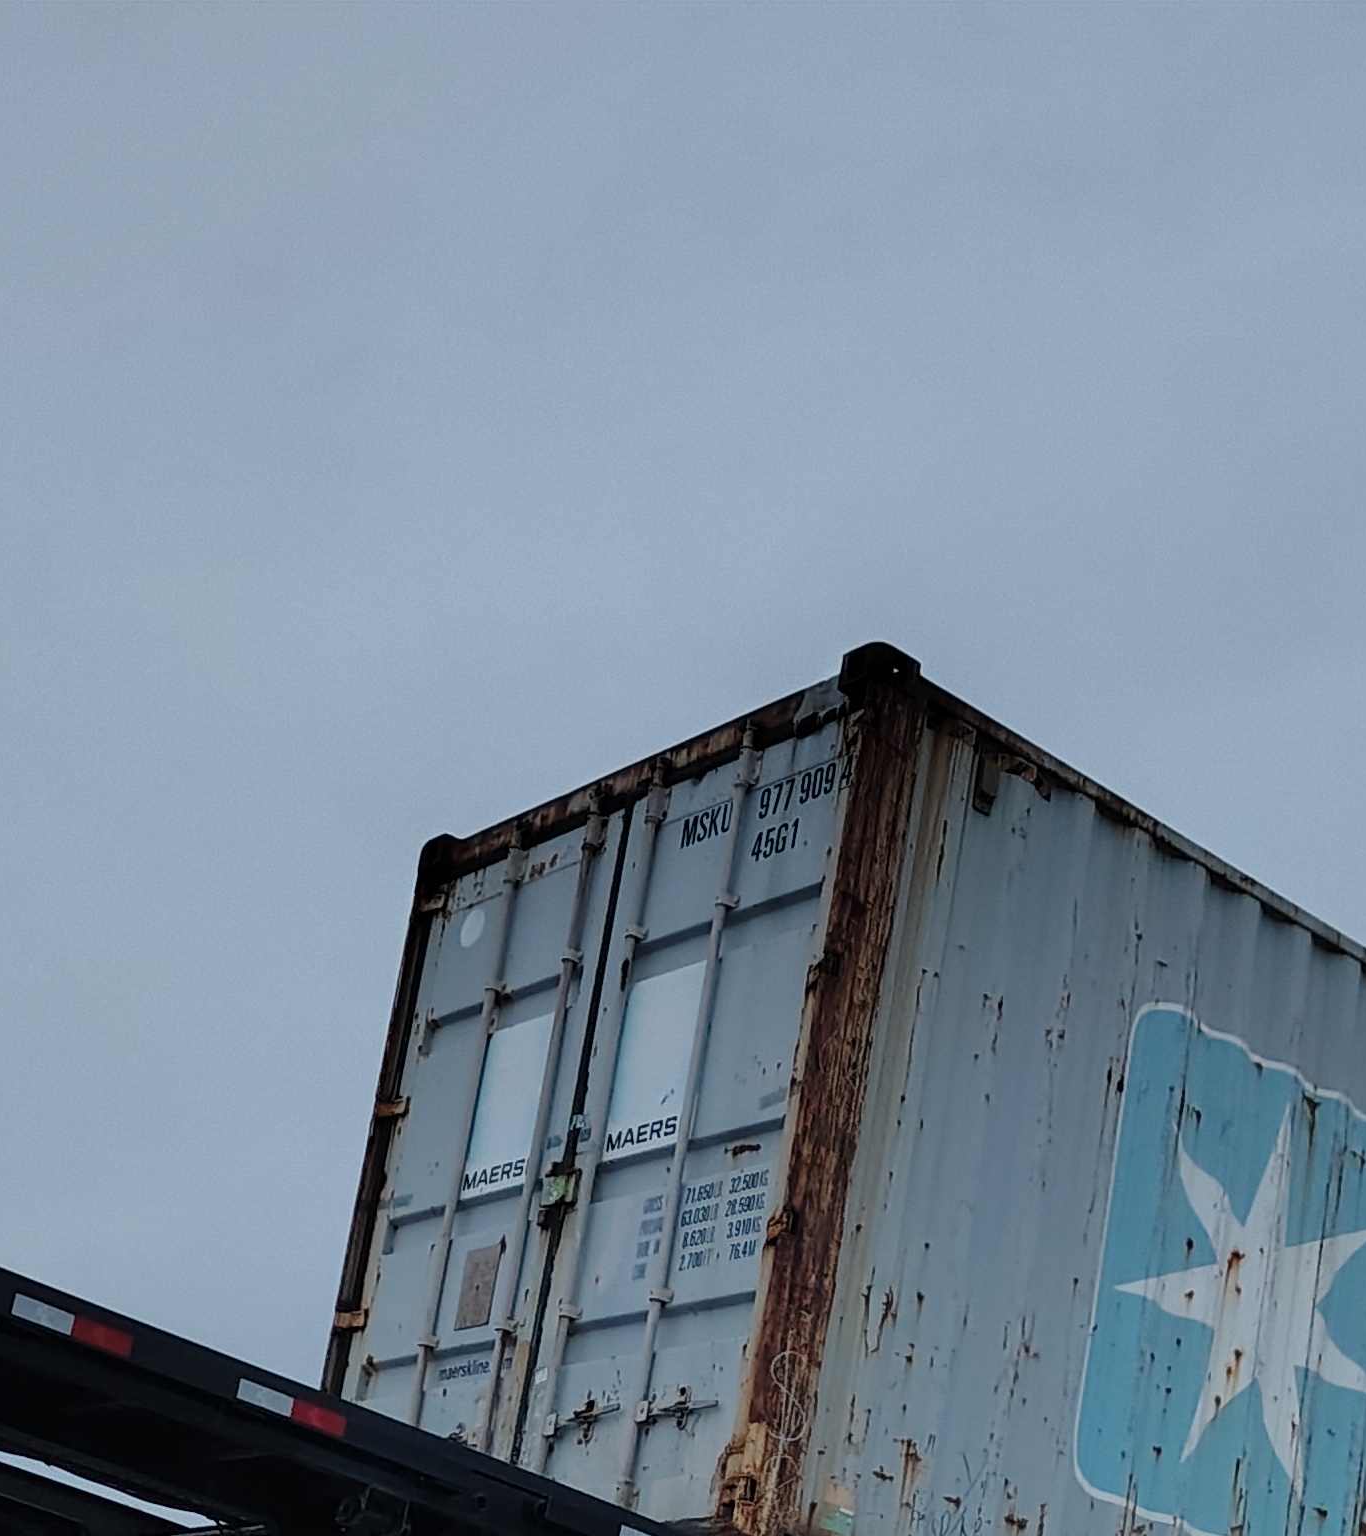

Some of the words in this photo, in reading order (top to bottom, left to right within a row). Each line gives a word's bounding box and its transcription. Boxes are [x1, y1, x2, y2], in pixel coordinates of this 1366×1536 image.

[680, 799, 733, 849] MSKU
[750, 818, 800, 862] 45G1
[606, 1115, 678, 1153] MAERS
[463, 1158, 526, 1191] MAERS
